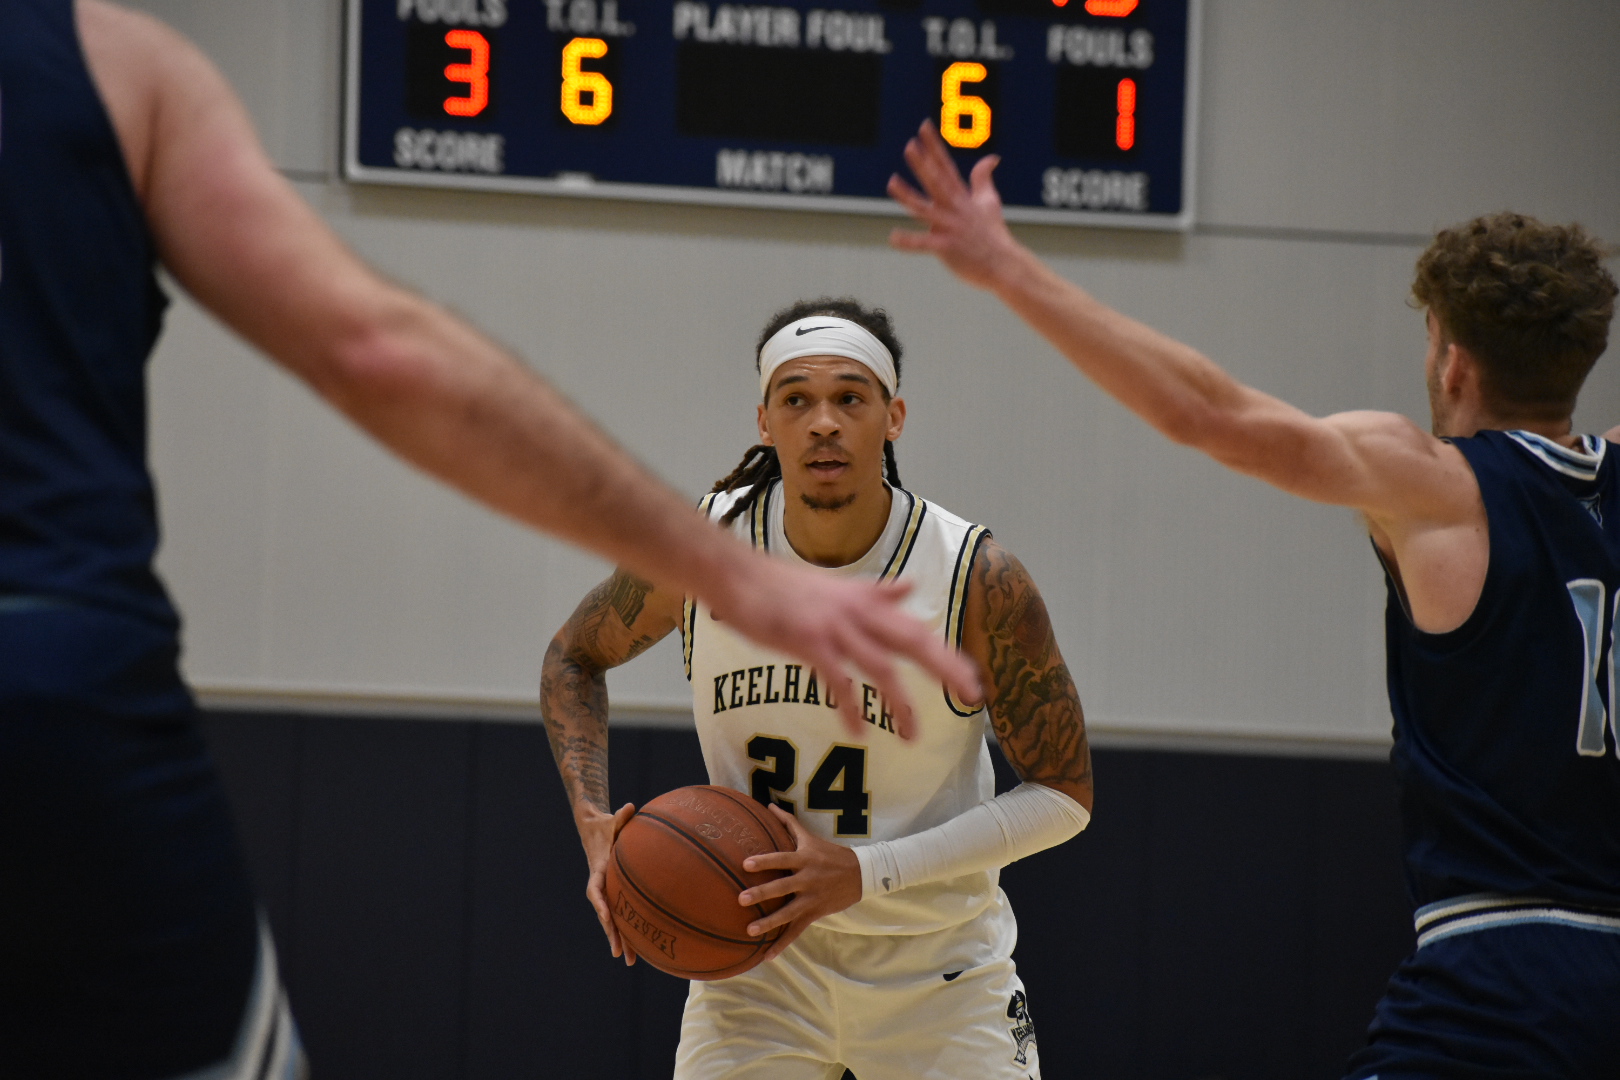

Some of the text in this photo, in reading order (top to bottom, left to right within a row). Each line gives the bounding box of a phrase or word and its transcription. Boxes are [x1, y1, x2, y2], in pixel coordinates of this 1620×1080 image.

[672, 2, 891, 54] PLAYER FOUL
[1047, 24, 1153, 68] FOULS
[443, 30, 490, 117] 3
[561, 37, 613, 126] 6
[940, 62, 991, 149] 6
[394, 127, 504, 173] SCORE
[1116, 78, 1137, 151] 1
[716, 149, 835, 193] MATCH
[1042, 167, 1149, 211] SCORE
[713, 664, 914, 741] KEELHAUER
[745, 732, 872, 839] 24
[614, 890, 677, 961] NAIA
